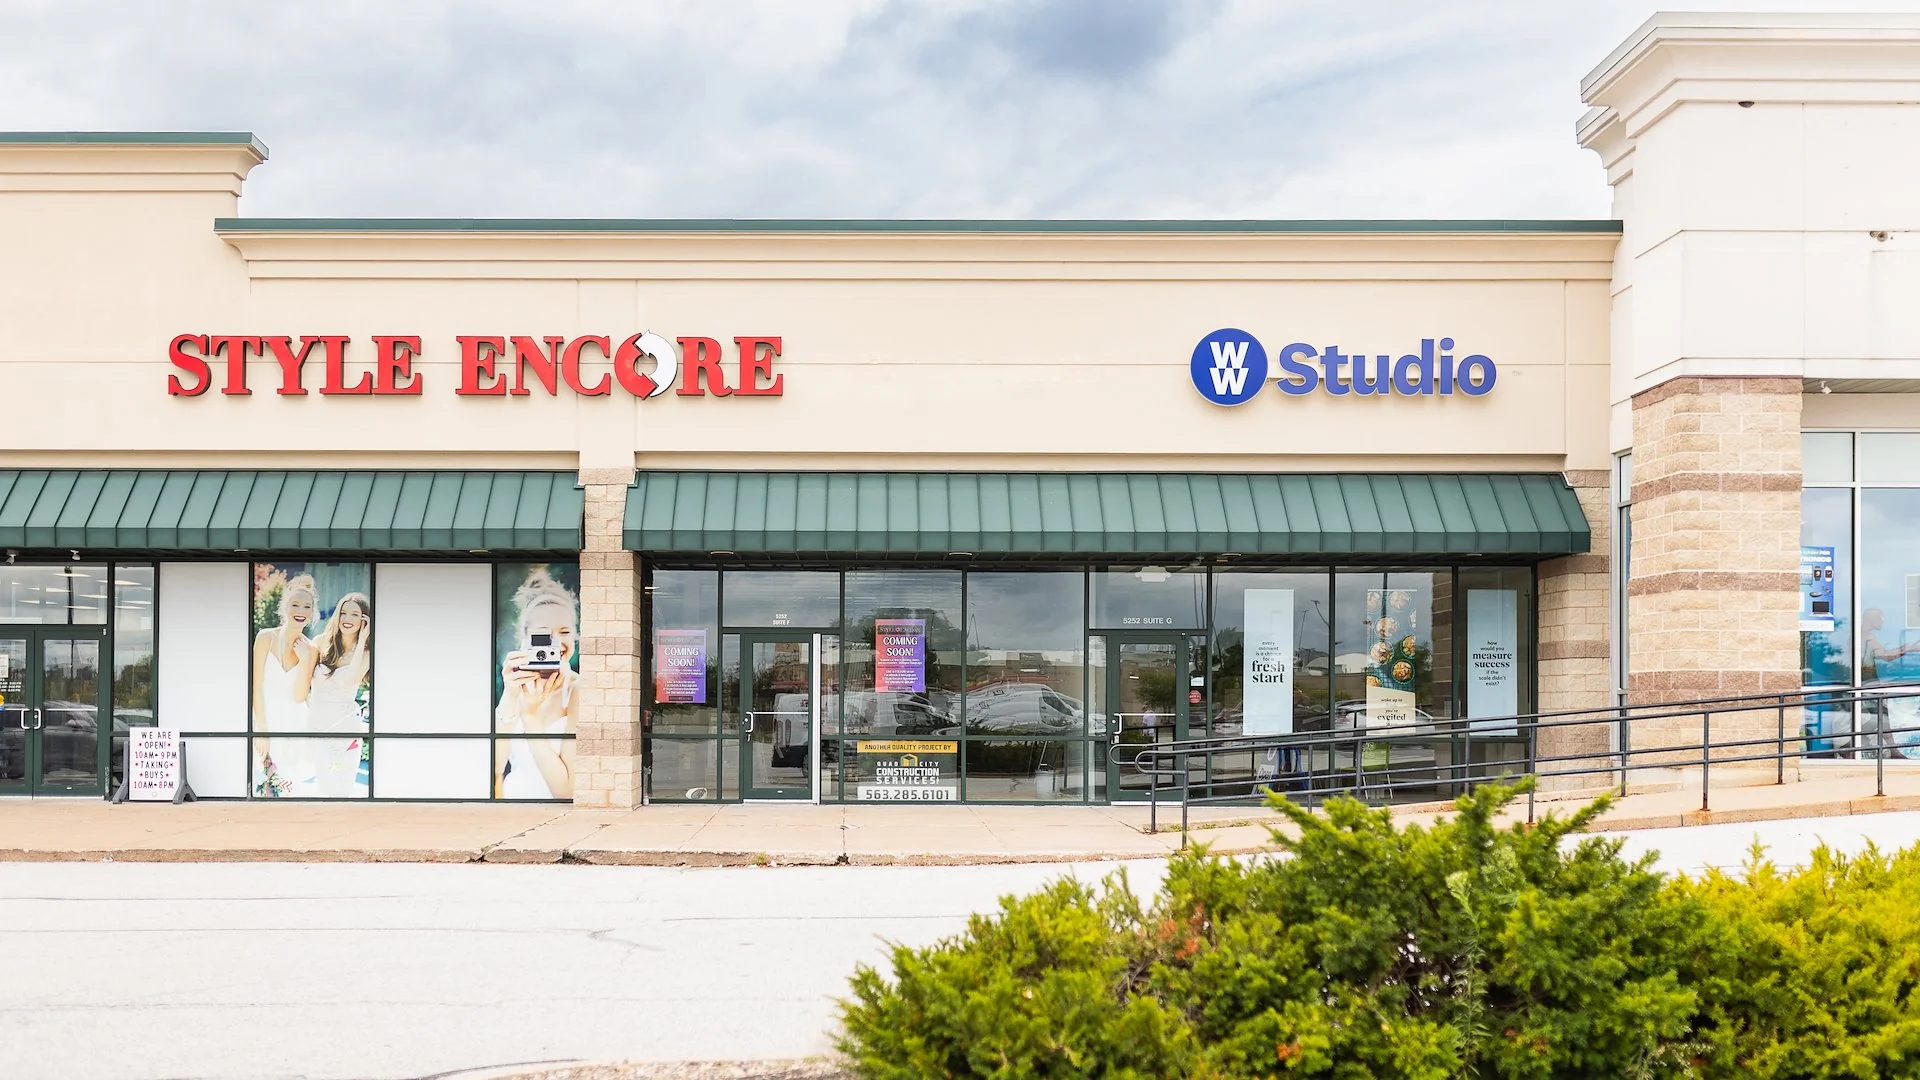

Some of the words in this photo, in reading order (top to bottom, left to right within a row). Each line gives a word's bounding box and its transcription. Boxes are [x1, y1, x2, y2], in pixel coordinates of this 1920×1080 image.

[167, 334, 423, 398] STYLE
[455, 329, 785, 402] ENCORE
[1276, 337, 1497, 397] Studio
[883, 637, 918, 645] COMING
[664, 648, 698, 656] COMING
[886, 648, 914, 656] SOON!
[1252, 660, 1284, 672] fresh
[1252, 673, 1284, 683] start
[141, 731, 153, 739] WE
[157, 731, 172, 739] ARE
[144, 741, 166, 749] OPEN!
[140, 761, 169, 769] TAKING
[144, 771, 164, 779] BUYS
[876, 767, 940, 776] CONSTRUCTION
[876, 777, 936, 785] SERVICES
[866, 789, 949, 800] 563.285.6101
